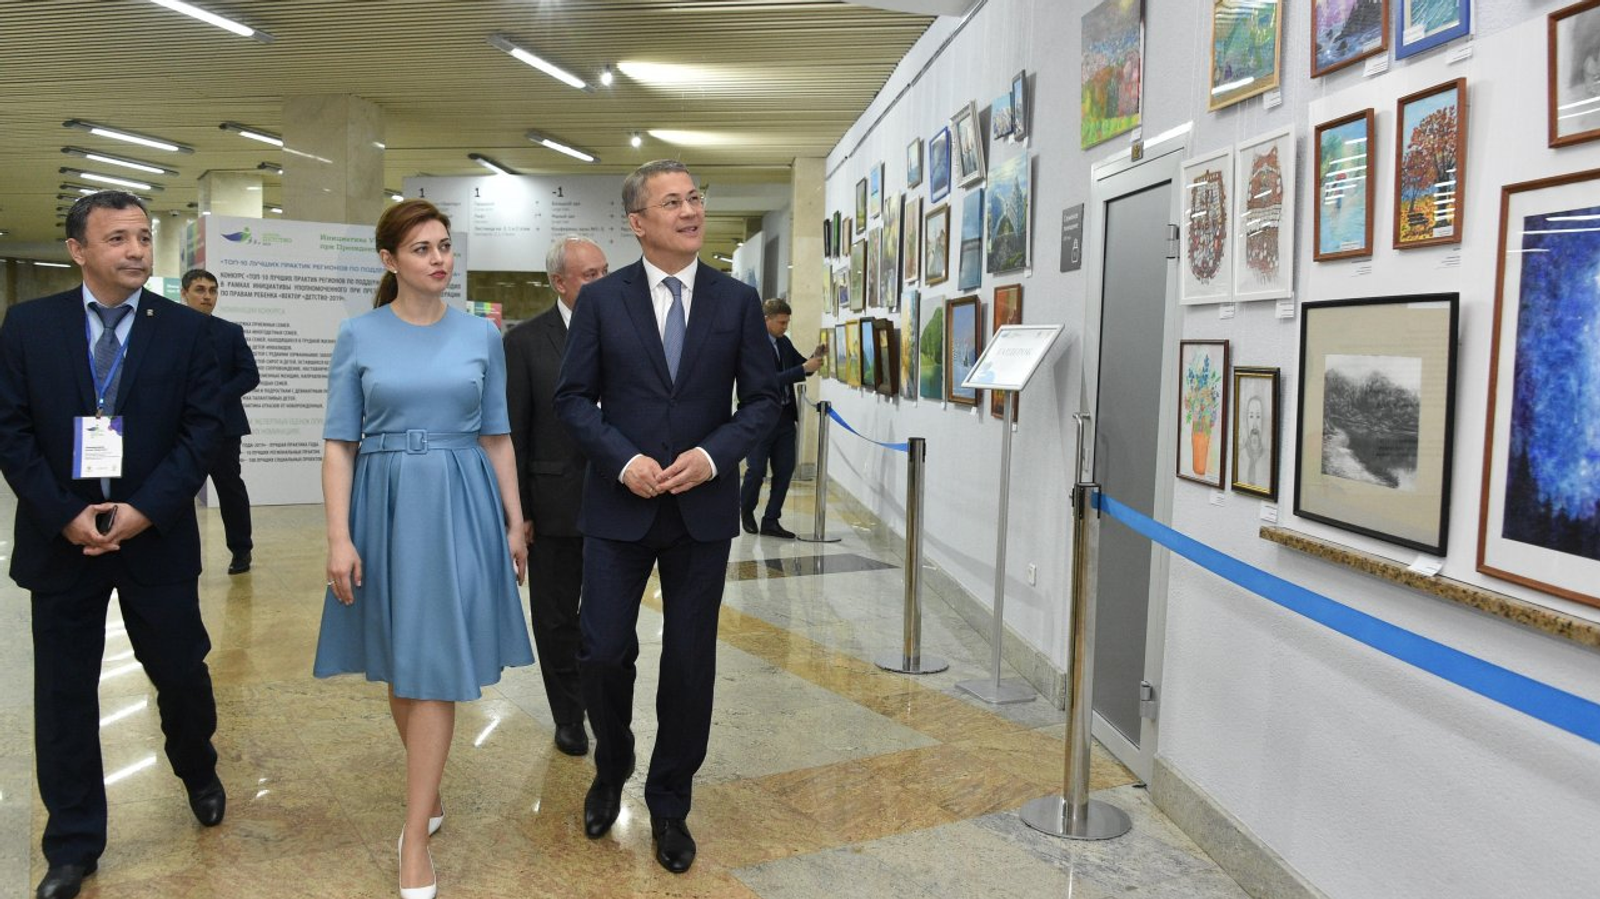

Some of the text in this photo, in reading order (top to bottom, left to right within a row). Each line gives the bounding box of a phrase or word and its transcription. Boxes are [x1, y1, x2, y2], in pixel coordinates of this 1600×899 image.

[418, 187, 425, 198] 1
[474, 187, 481, 198] 1
[552, 186, 564, 197] -1
[249, 260, 279, 268] ЛУЧШИХ
[269, 274, 293, 282] ЛУЧШИХ
[293, 285, 348, 293] УПОЛНОМОЧЕННОГО
